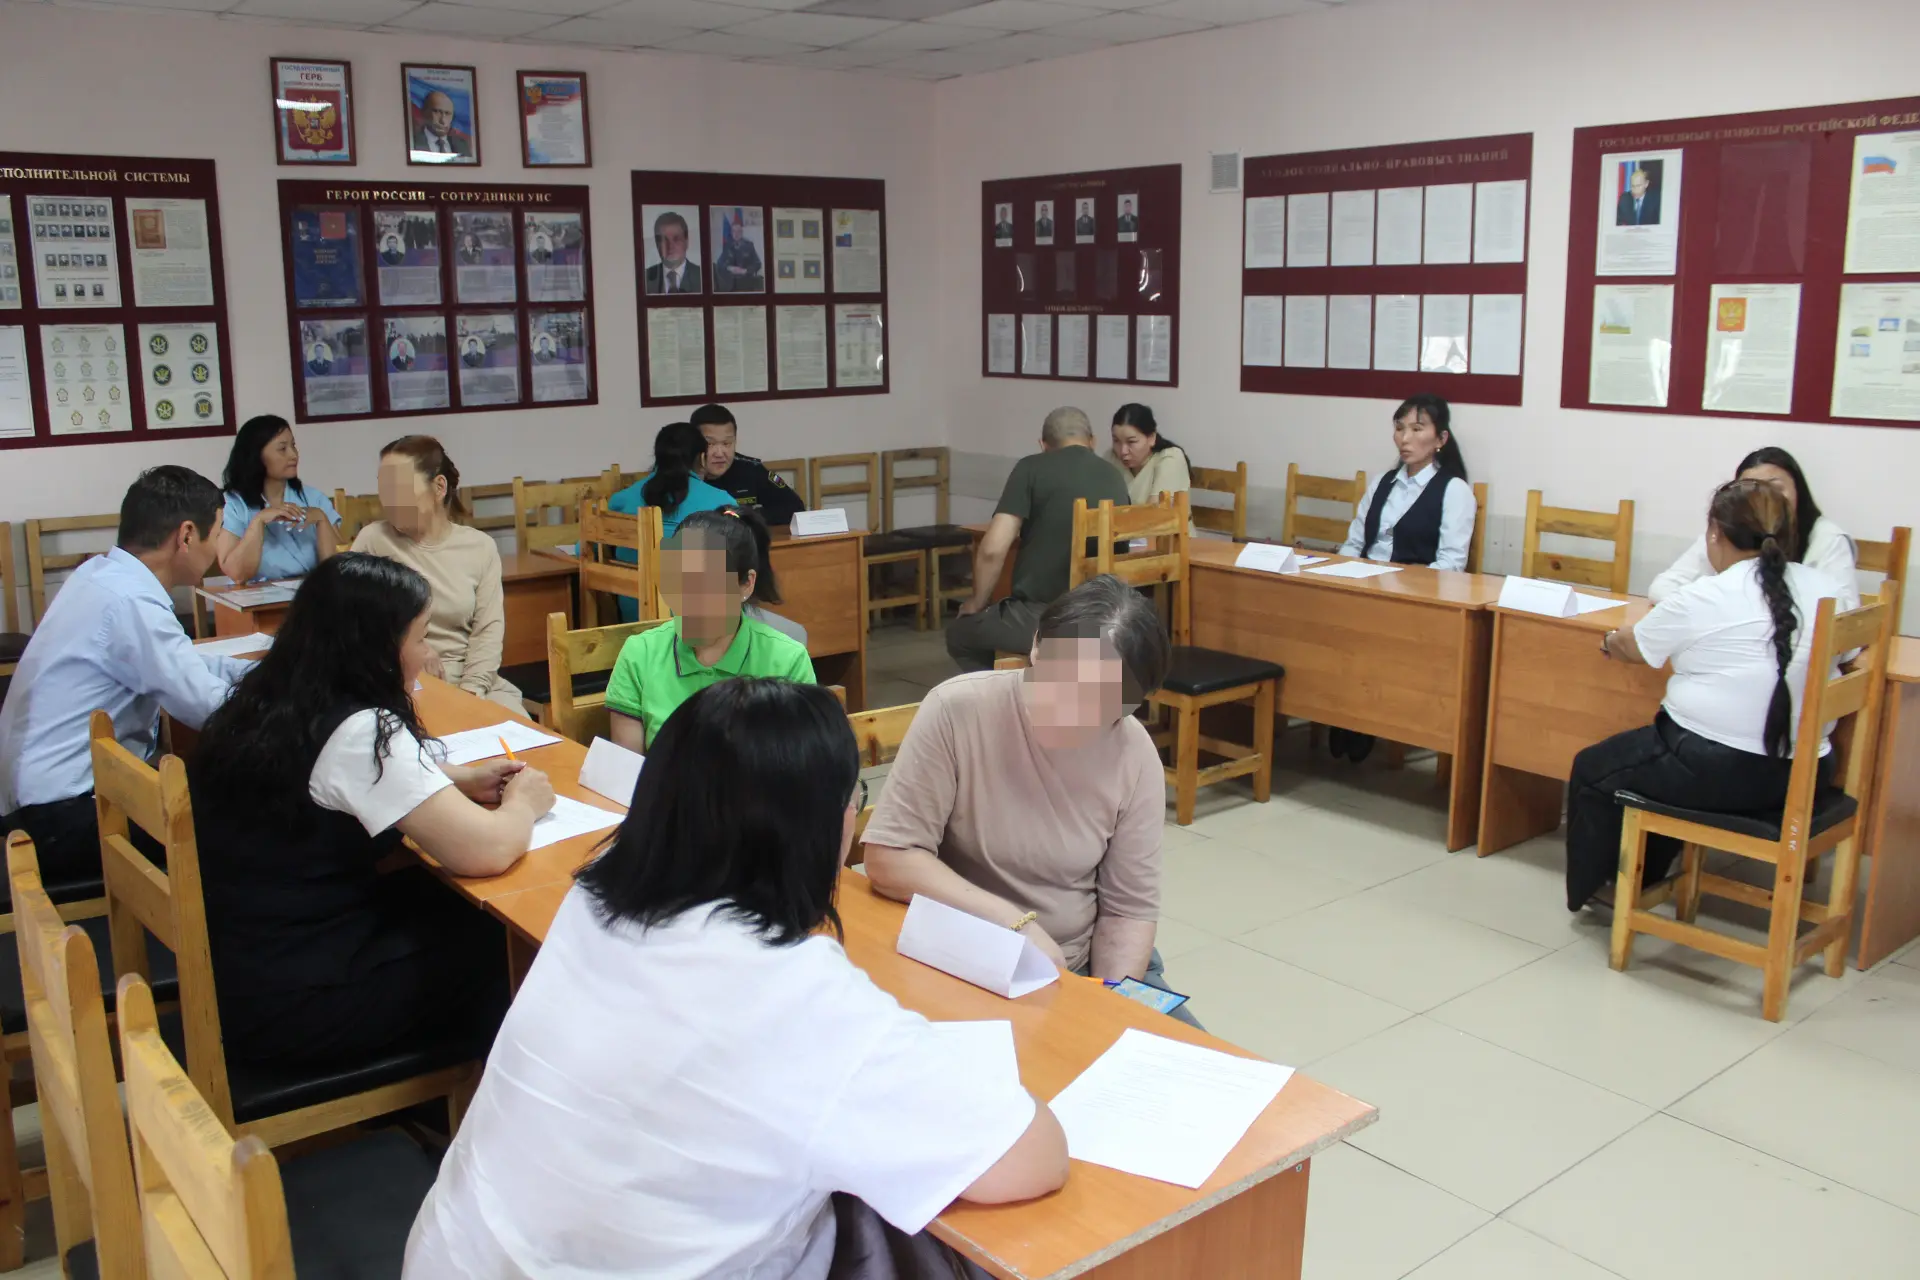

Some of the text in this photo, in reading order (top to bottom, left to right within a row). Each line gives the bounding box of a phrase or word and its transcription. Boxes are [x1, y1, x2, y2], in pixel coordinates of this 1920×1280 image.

[1783, 114, 1877, 134] РОССИЙСКОЙ
[124, 171, 190, 184] СИСТЕМЫ
[326, 189, 370, 200] ГЕРОИ
[373, 189, 426, 201] РОССИИ
[440, 191, 524, 202] СОТРУДНИКИ
[527, 192, 552, 202] УИС
